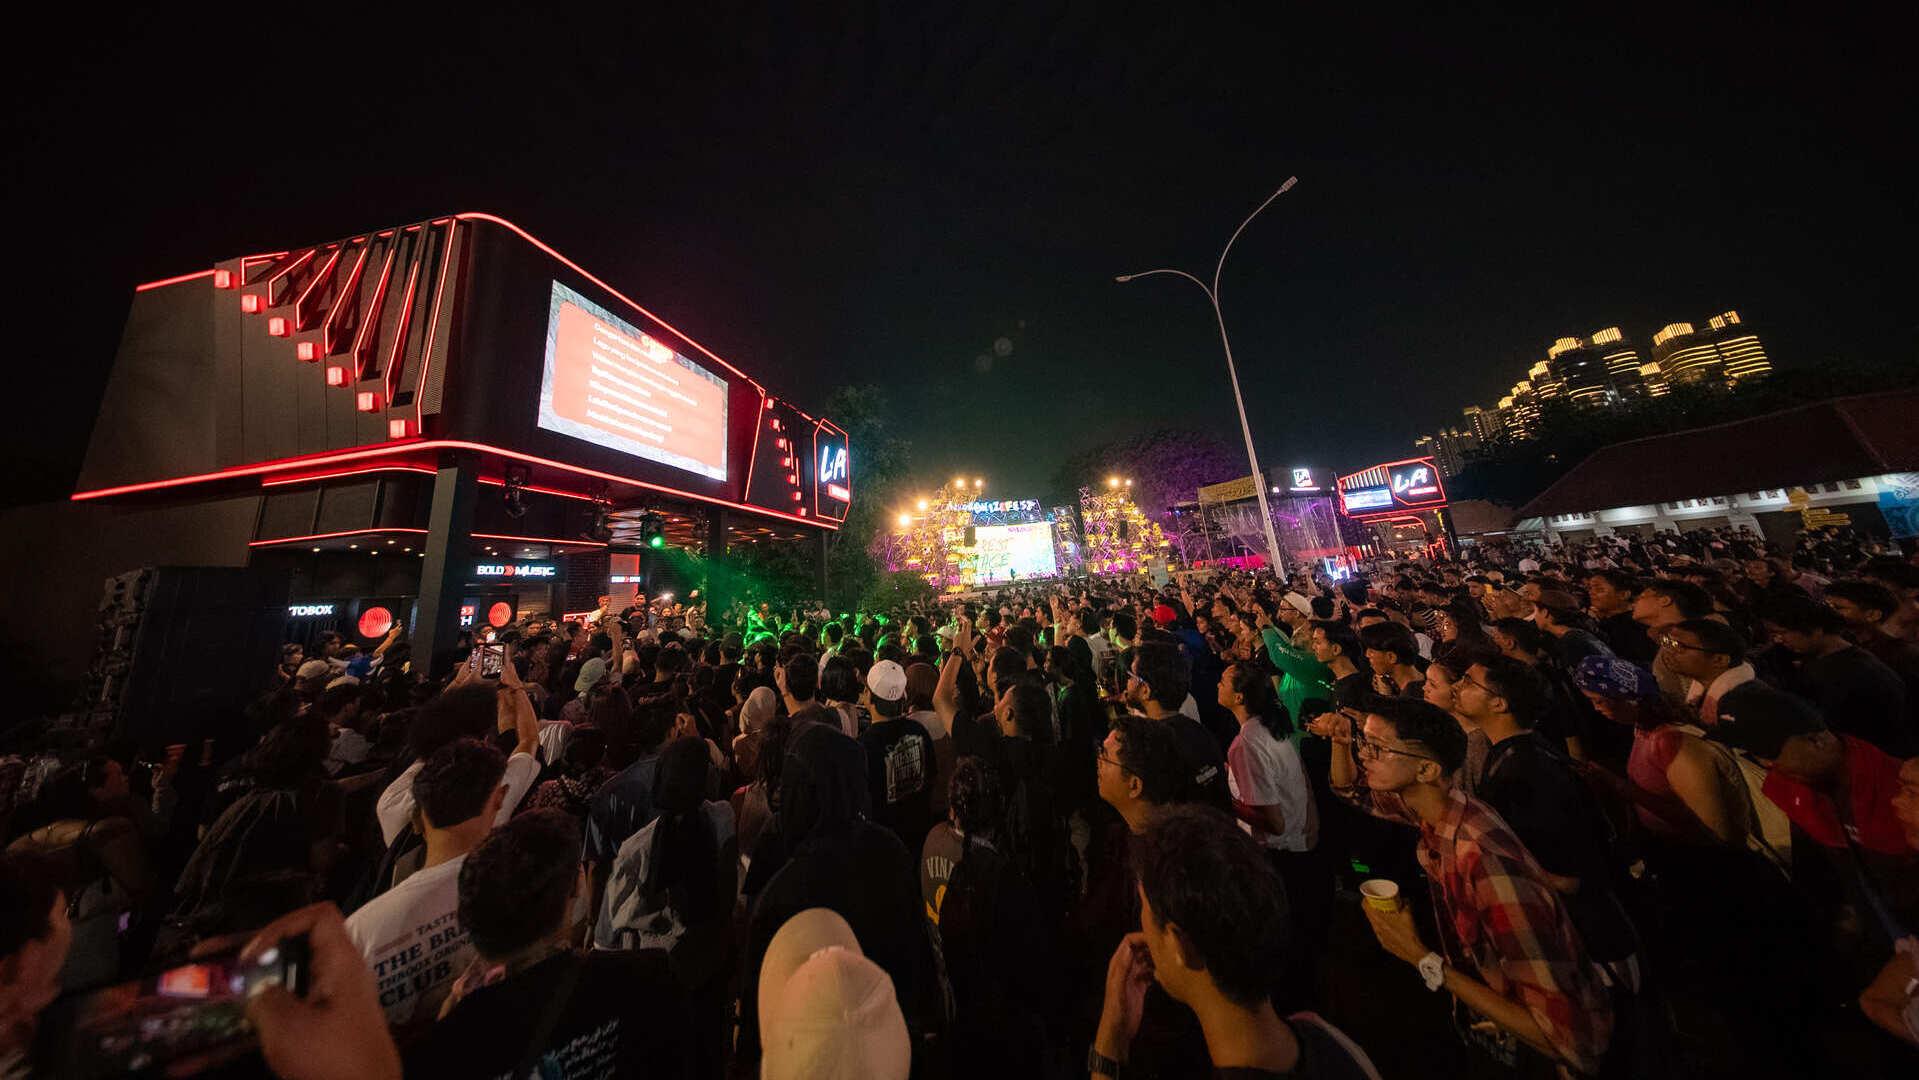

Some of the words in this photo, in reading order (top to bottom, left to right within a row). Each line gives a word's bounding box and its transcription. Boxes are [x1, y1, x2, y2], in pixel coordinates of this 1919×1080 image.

[820, 445, 847, 483] LA
[1394, 467, 1428, 493] LA
[477, 565, 504, 575] BOLD
[515, 565, 555, 576] MUSIC
[374, 943, 423, 977] THE
[380, 961, 450, 1006] CLUB
